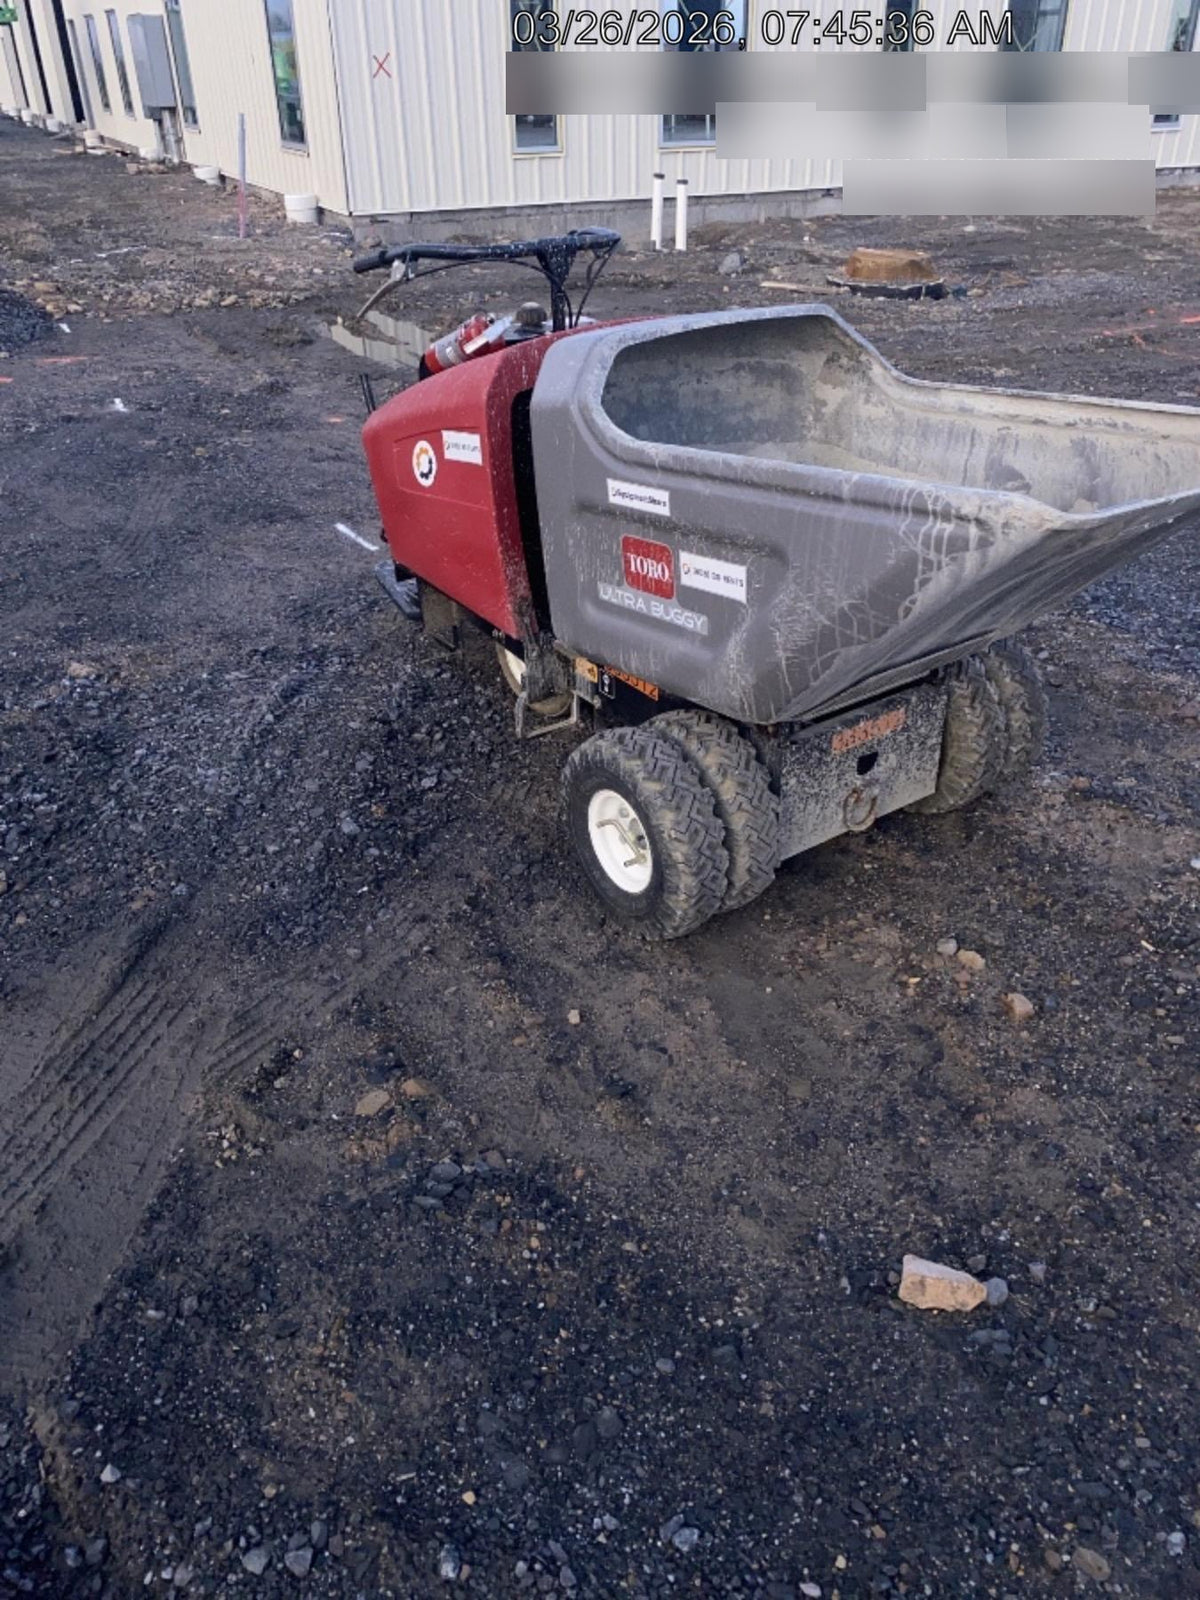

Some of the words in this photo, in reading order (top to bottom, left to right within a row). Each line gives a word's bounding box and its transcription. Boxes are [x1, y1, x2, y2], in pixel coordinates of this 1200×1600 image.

[627, 552, 670, 582] TORO
[599, 584, 648, 614] ULTRA
[650, 600, 704, 630] BUGGY
